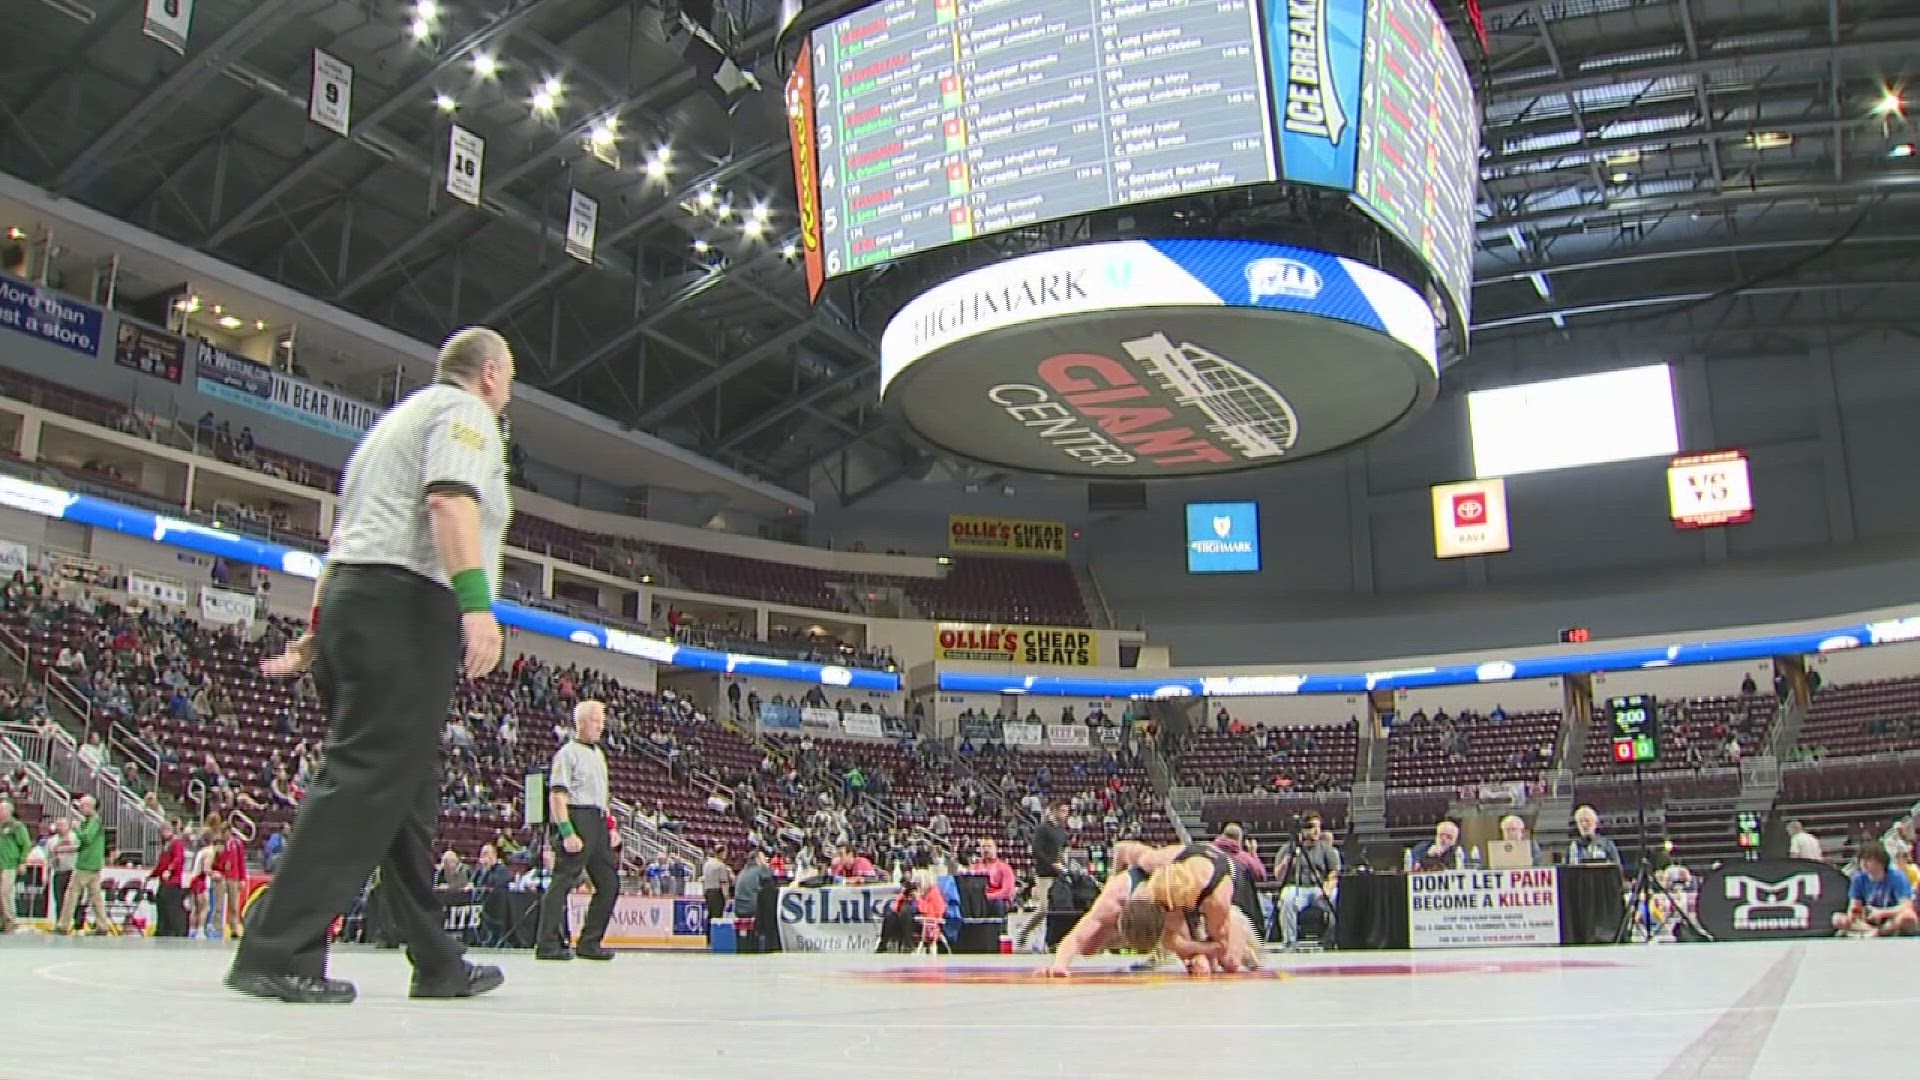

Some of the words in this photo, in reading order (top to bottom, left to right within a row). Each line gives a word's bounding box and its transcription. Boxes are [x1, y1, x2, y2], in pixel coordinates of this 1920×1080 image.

[816, 43, 826, 67] 1
[326, 83, 338, 104] 9
[817, 83, 831, 109] 2
[1285, 84, 1332, 137] ICE
[820, 124, 833, 150] 3
[455, 154, 475, 176] 16
[822, 164, 836, 190] 4
[575, 219, 589, 239] 17
[824, 207, 838, 234] 5
[827, 249, 841, 277] 6
[44, 299, 85, 326] than
[914, 267, 1088, 346] HIGHMARK
[43, 322, 95, 350] store.
[294, 385, 329, 416] BEAR
[1037, 353, 1234, 465] GIANT
[988, 383, 1137, 467] CENTER
[952, 520, 1011, 539] OLLIE'S
[1013, 523, 1063, 538] CHEAP
[1014, 535, 1063, 551] SEATS
[939, 629, 1018, 653] OLLIE'S
[1023, 630, 1090, 649] CHEAP
[1025, 647, 1090, 666] SEATS
[1618, 743, 1630, 758] 0
[1637, 742, 1649, 757] 0
[1412, 874, 1466, 893] DON'T
[1472, 872, 1503, 890] LET
[1510, 869, 1553, 888] PAIN
[1412, 893, 1478, 911] BECOME
[1482, 893, 1493, 908] A
[1498, 891, 1553, 907] KILLER
[796, 934, 841, 951] Sports
